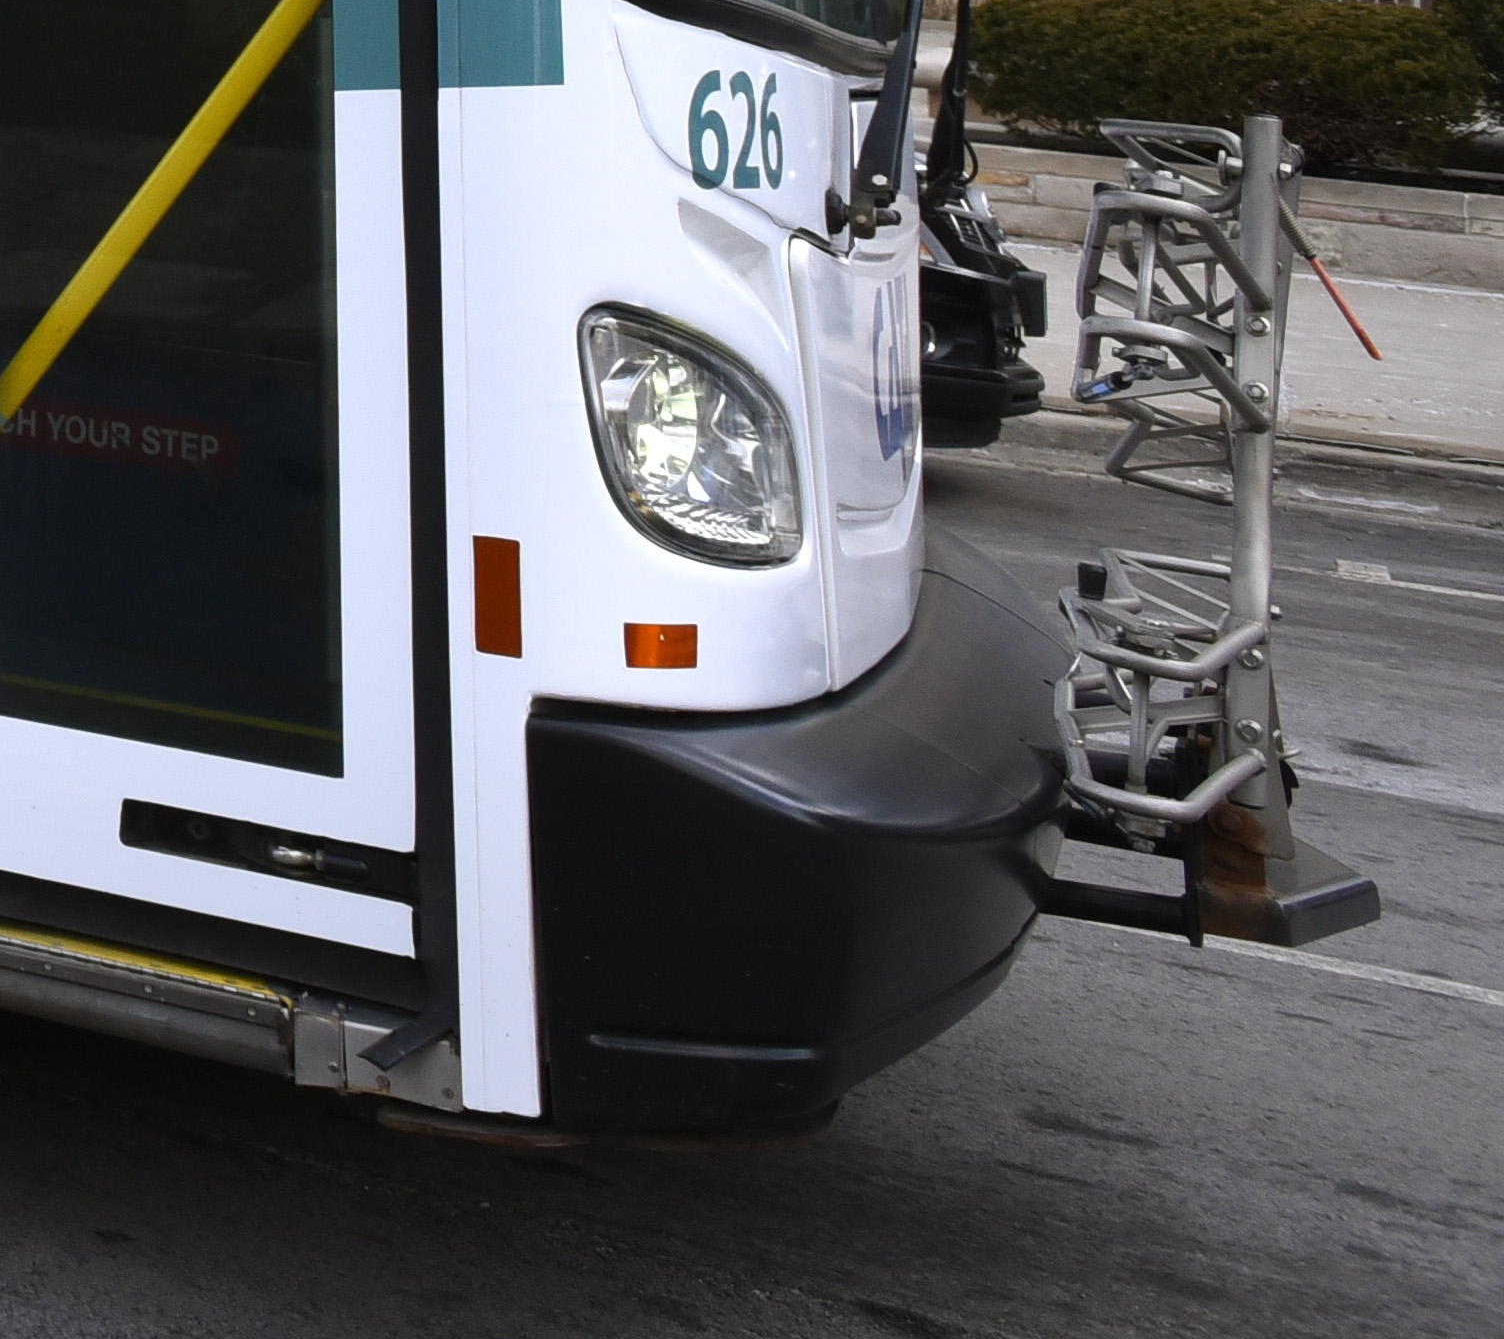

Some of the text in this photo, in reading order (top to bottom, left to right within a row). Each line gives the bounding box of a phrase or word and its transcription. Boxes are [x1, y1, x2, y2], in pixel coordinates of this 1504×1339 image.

[688, 69, 783, 190] 626
[47, 412, 131, 451] YOUR
[141, 426, 221, 461] STEP
